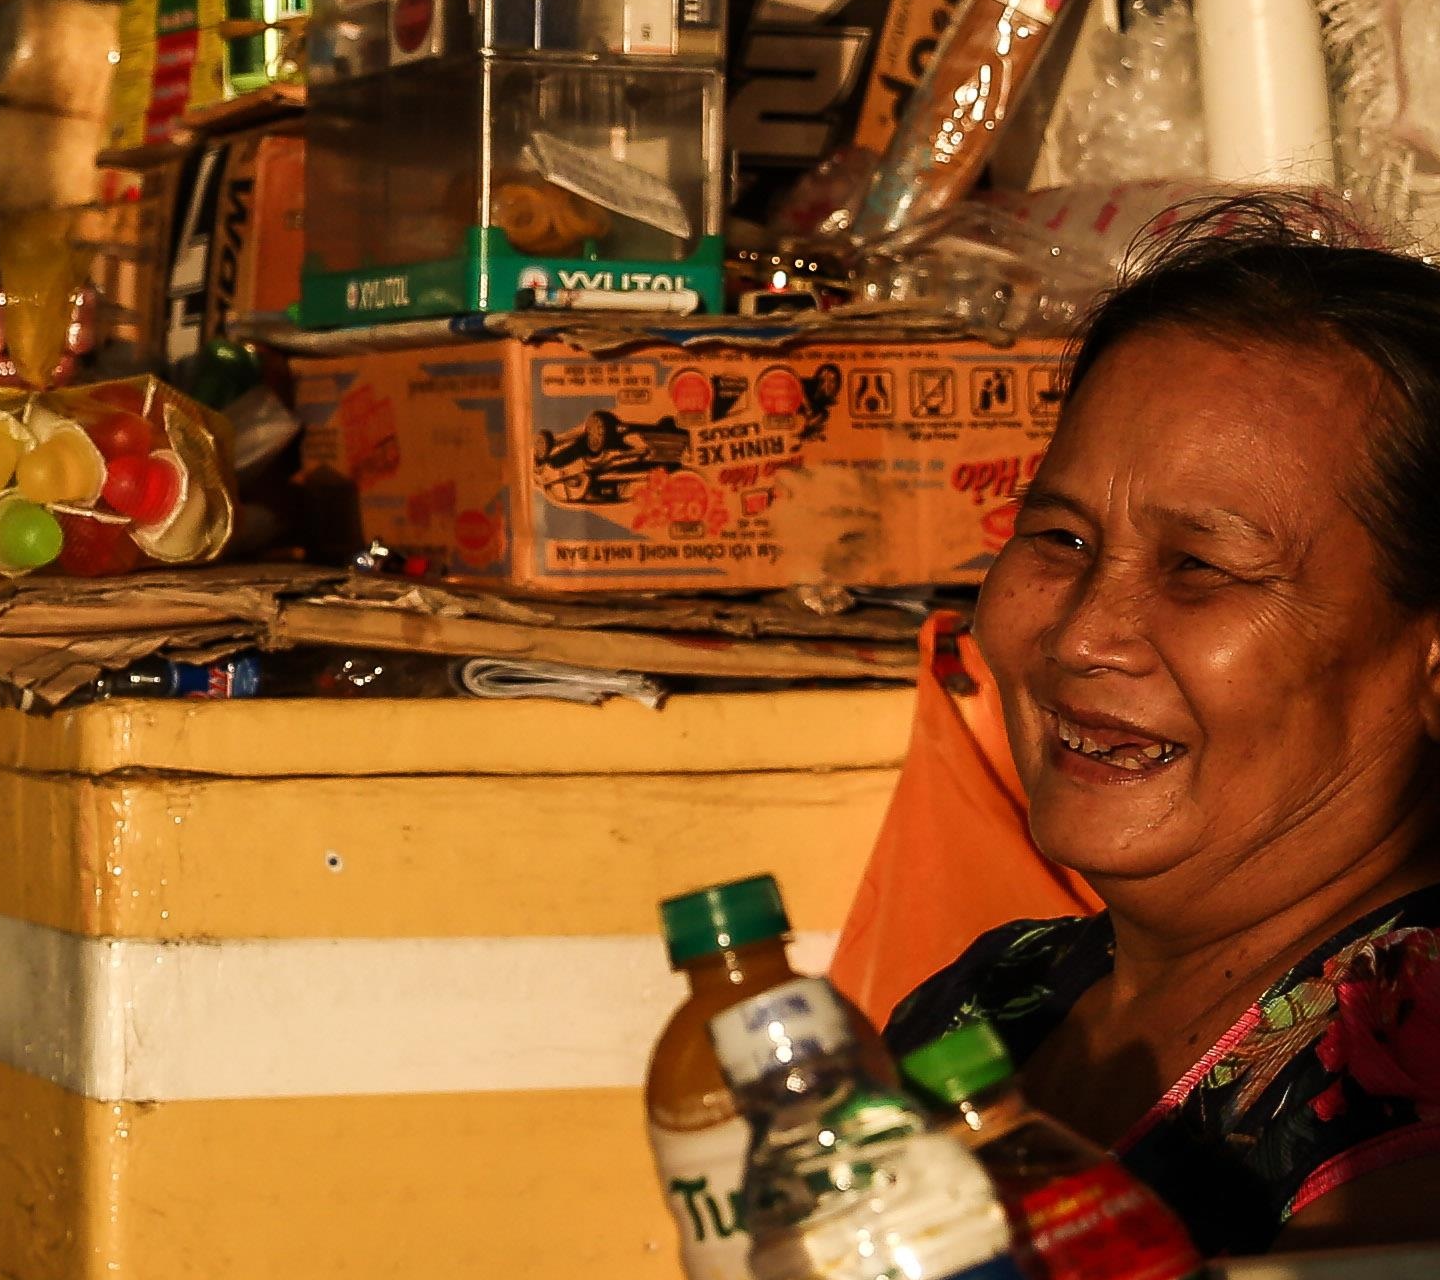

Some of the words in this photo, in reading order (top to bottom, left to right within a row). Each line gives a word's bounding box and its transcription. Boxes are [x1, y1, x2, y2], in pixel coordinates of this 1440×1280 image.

[696, 443, 725, 466] XE
[730, 435, 785, 462] RINH
[951, 457, 1019, 505] Hảo
